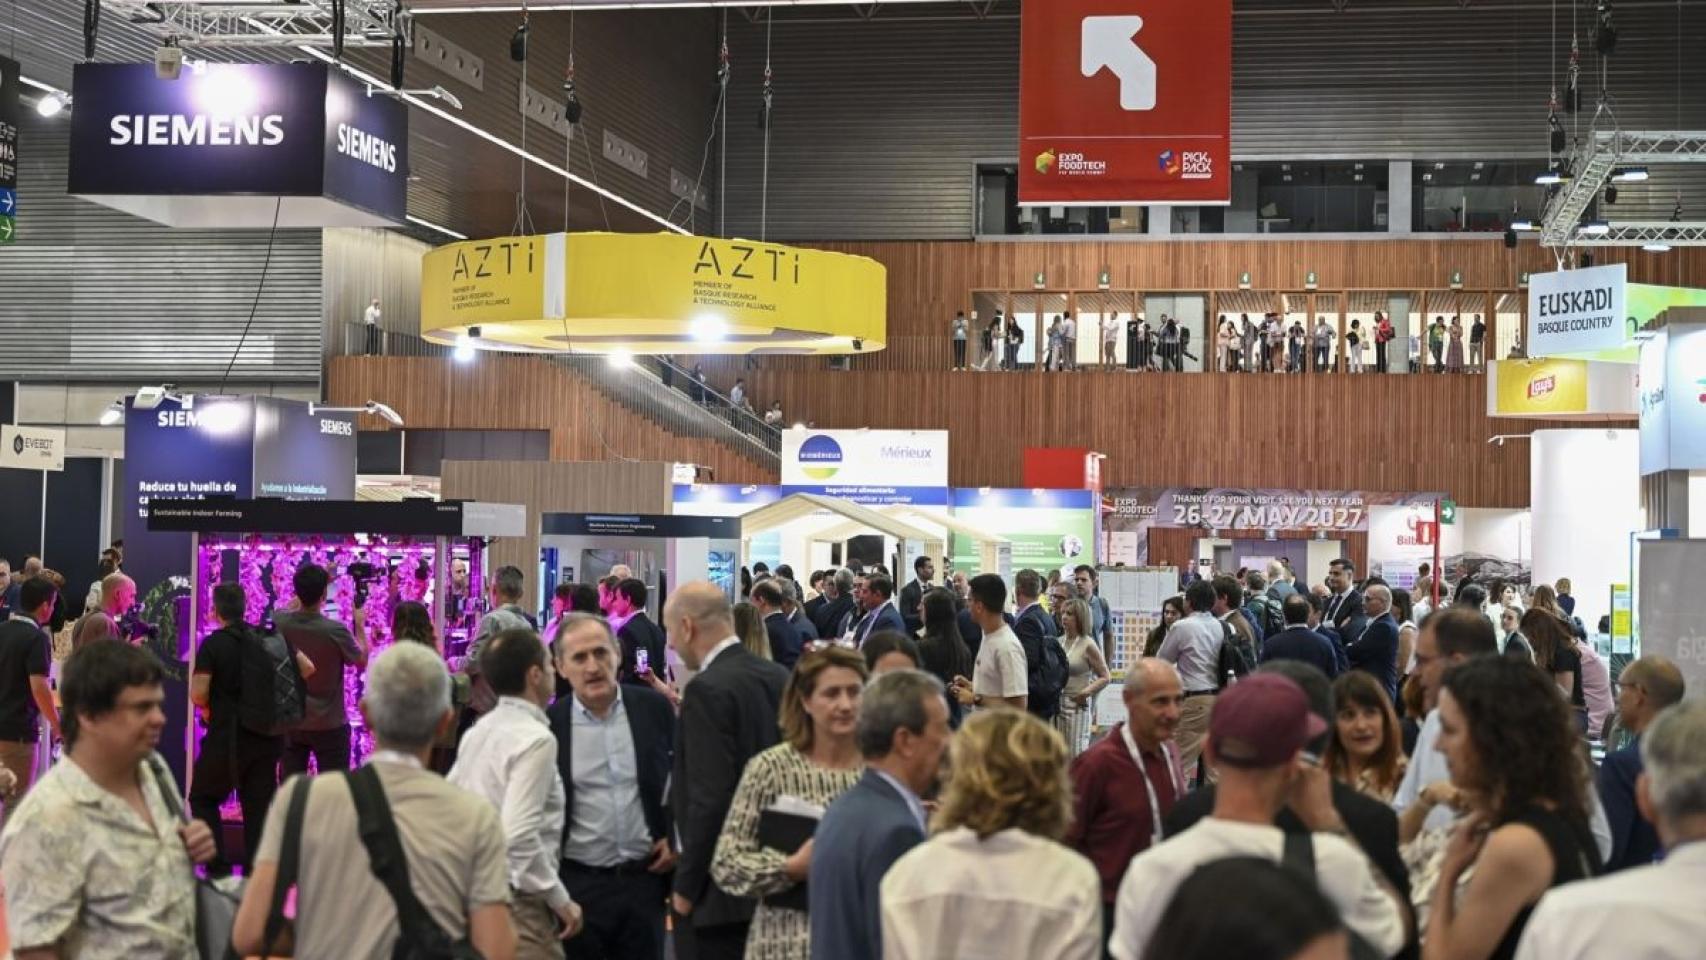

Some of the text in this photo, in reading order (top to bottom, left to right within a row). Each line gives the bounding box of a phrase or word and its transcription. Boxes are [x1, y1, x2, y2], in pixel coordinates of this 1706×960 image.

[109, 114, 285, 146] SIEMENS
[336, 121, 397, 174] SIEMENS
[1058, 153, 1084, 162] EXPO
[1058, 161, 1106, 170] FOODTECH
[1182, 163, 1212, 173] PACK
[694, 281, 733, 290] MEMBER OF
[693, 289, 757, 301] BASQUE RESEARCH
[700, 298, 745, 308] TECHNOLOGY
[746, 302, 776, 312] ALLIANCE
[1539, 287, 1613, 317] EUSKADI
[1537, 320, 1570, 336] BASQUE
[1570, 316, 1614, 333] COUNTRY
[319, 418, 352, 436] SIEMENS
[879, 445, 932, 459] Mérieux
[139, 481, 237, 492] Reduce tu huella de
[825, 486, 858, 496] Seguridad
[1172, 494, 1208, 504] THANKS
[1209, 495, 1226, 504] FOR
[1227, 495, 1251, 505] YOUR
[1278, 496, 1294, 506] SEE
[1295, 497, 1313, 507] YOU
[1314, 497, 1338, 507] NEXT
[1340, 497, 1363, 508] YEAR
[154, 508, 193, 517] Sustainable
[215, 508, 243, 519] Farming
[1114, 505, 1158, 514] FOODTECH
[1173, 505, 1363, 528] 26-27 MAY 2027
